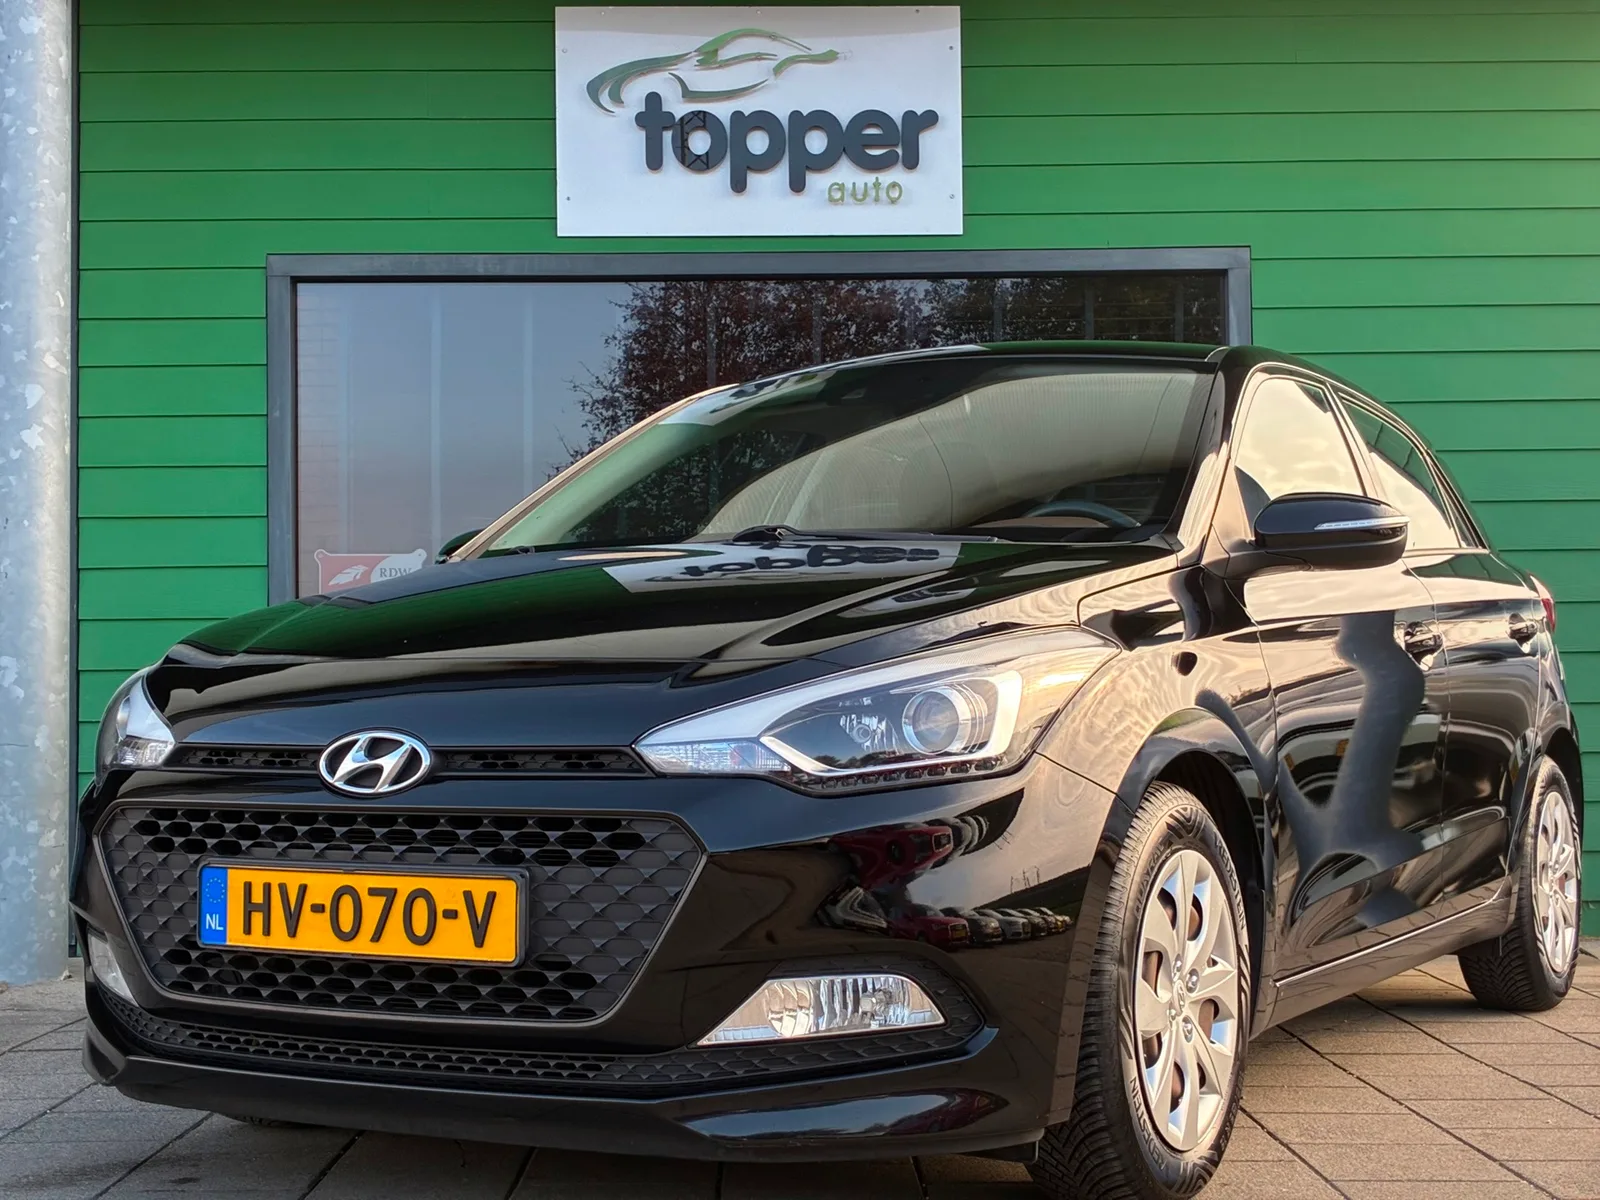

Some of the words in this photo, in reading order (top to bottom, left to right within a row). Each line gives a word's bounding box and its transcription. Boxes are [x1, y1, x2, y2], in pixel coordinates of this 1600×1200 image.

[634, 92, 939, 193] topper
[827, 177, 903, 205] auto
[380, 567, 411, 578] RDW
[206, 913, 224, 931] NL
[242, 881, 497, 948] HV-070-V
